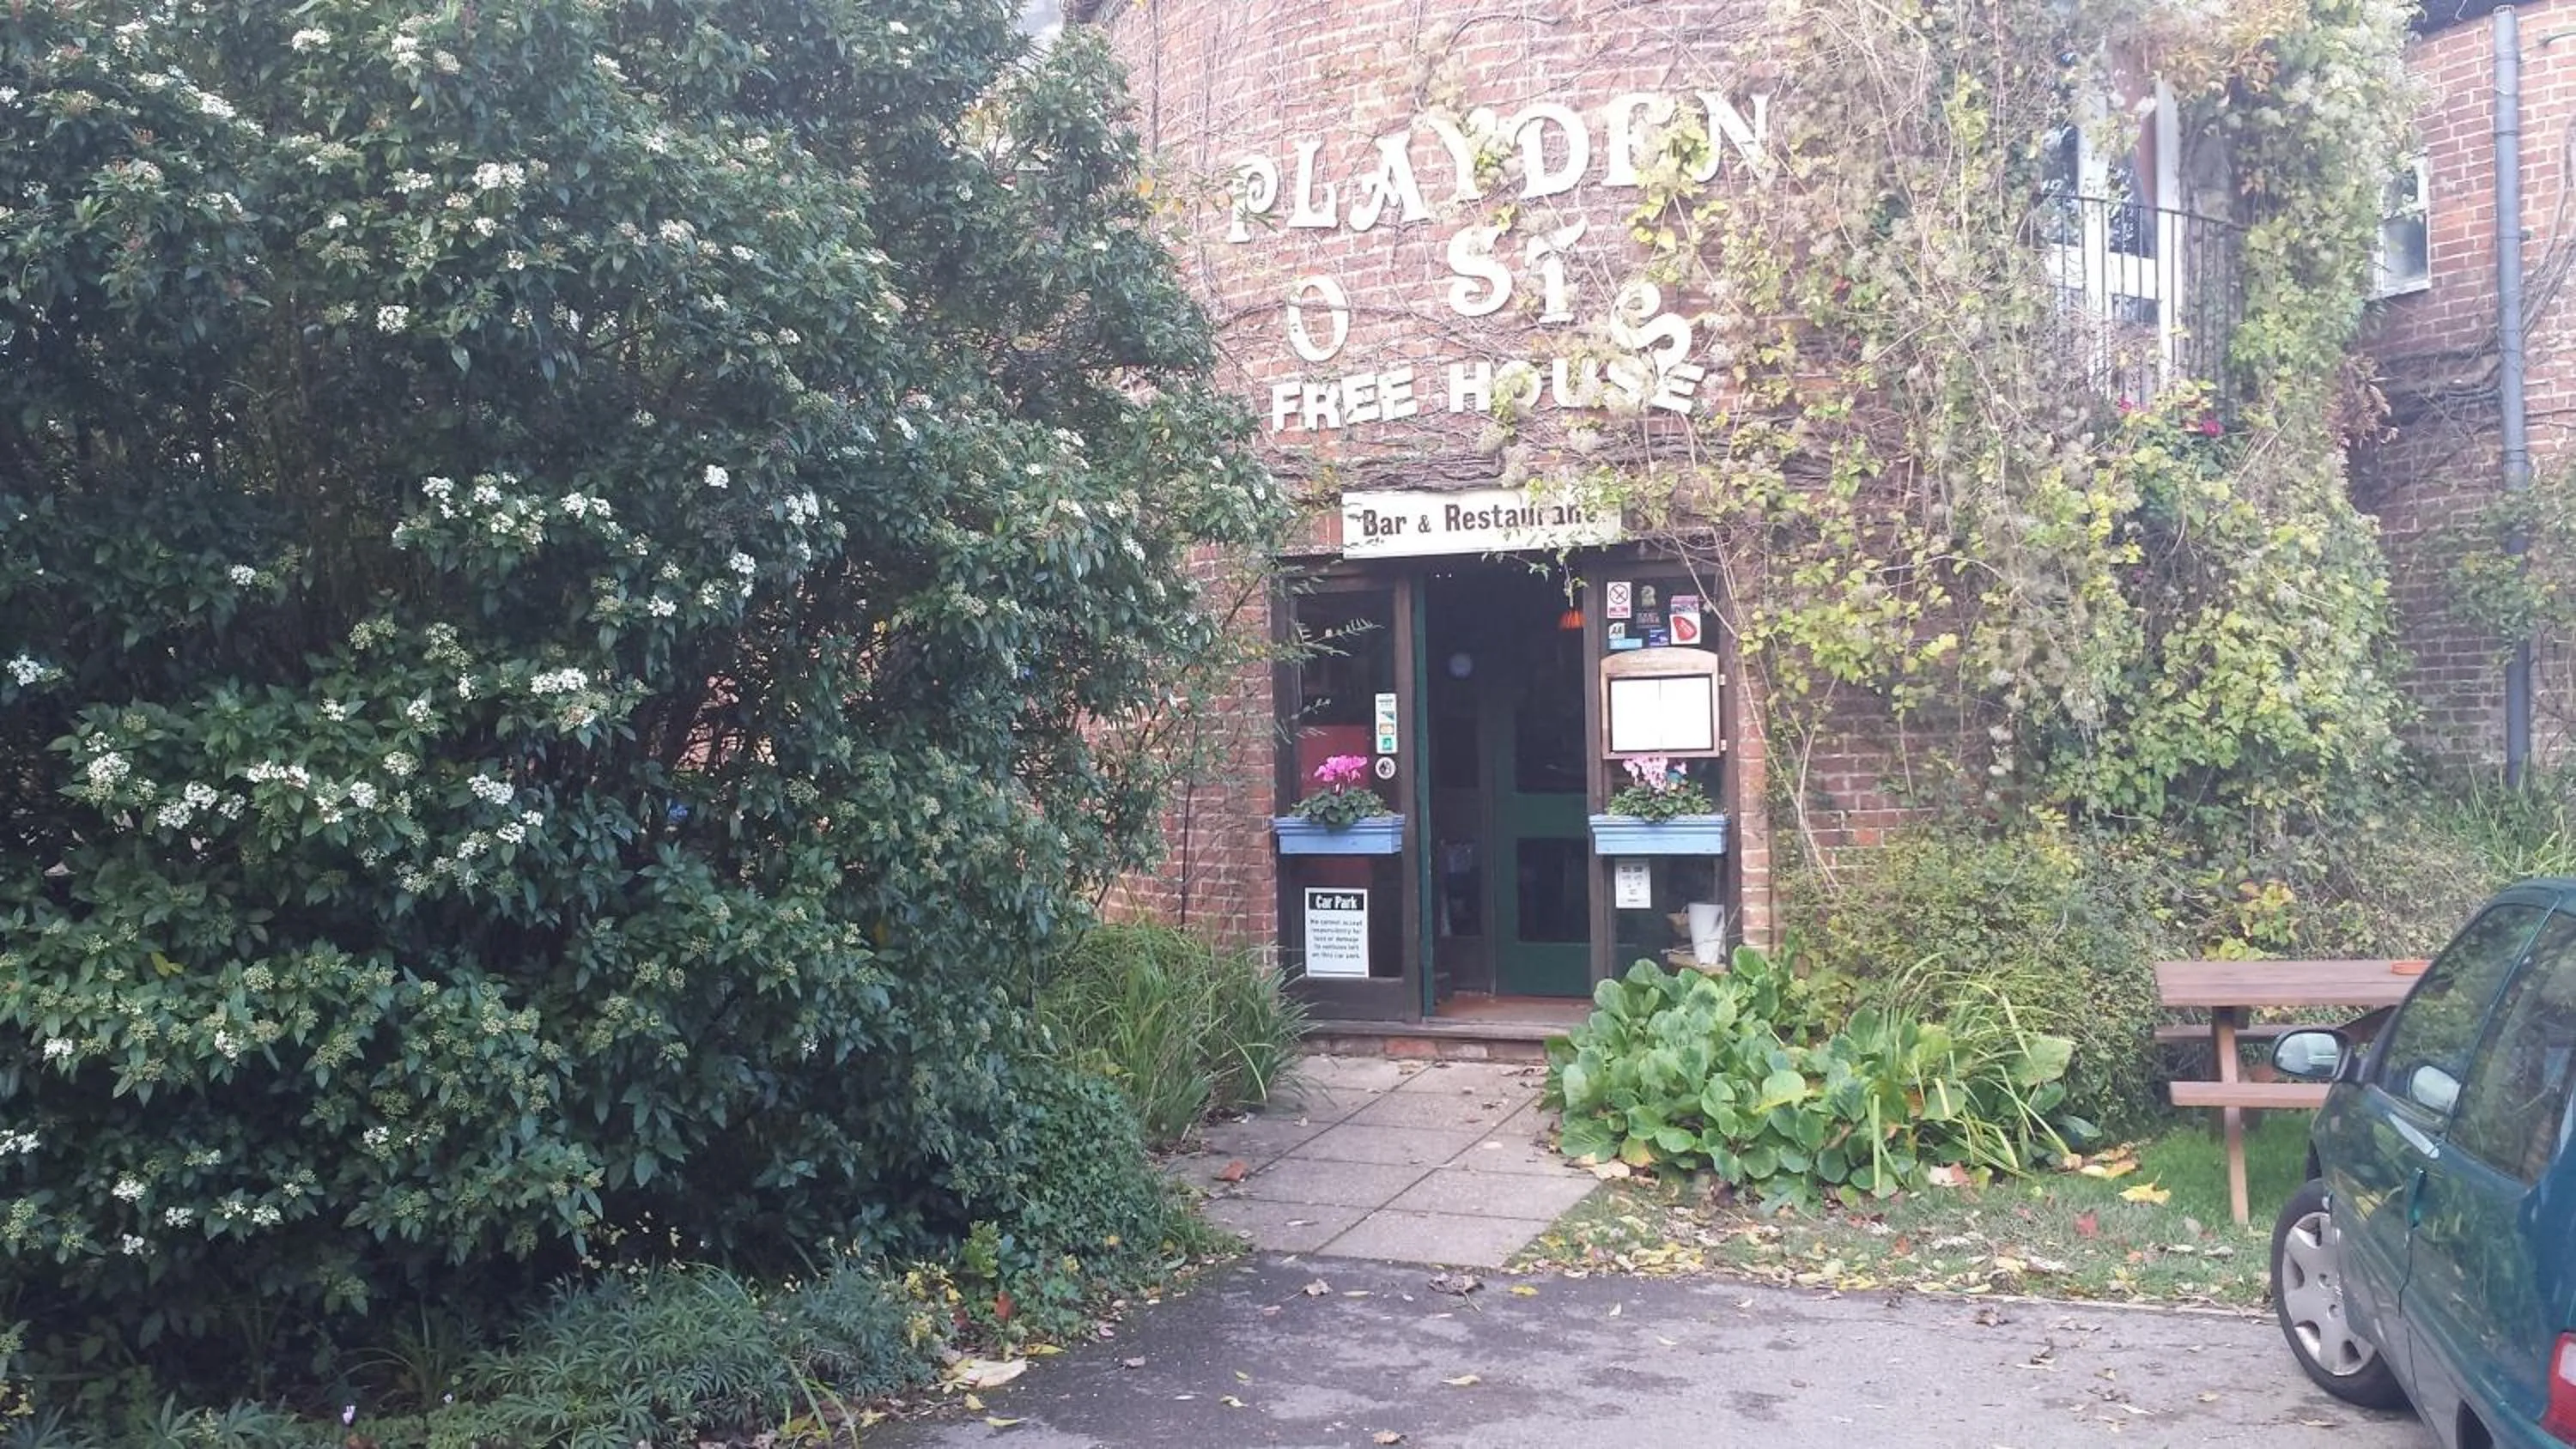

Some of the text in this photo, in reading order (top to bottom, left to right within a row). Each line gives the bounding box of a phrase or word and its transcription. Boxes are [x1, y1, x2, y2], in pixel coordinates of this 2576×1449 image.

[1271, 367, 1418, 430] FREE
[1363, 509, 1407, 537] Bar
[1418, 514, 1431, 533] &
[1315, 894, 1358, 909] Car Park
